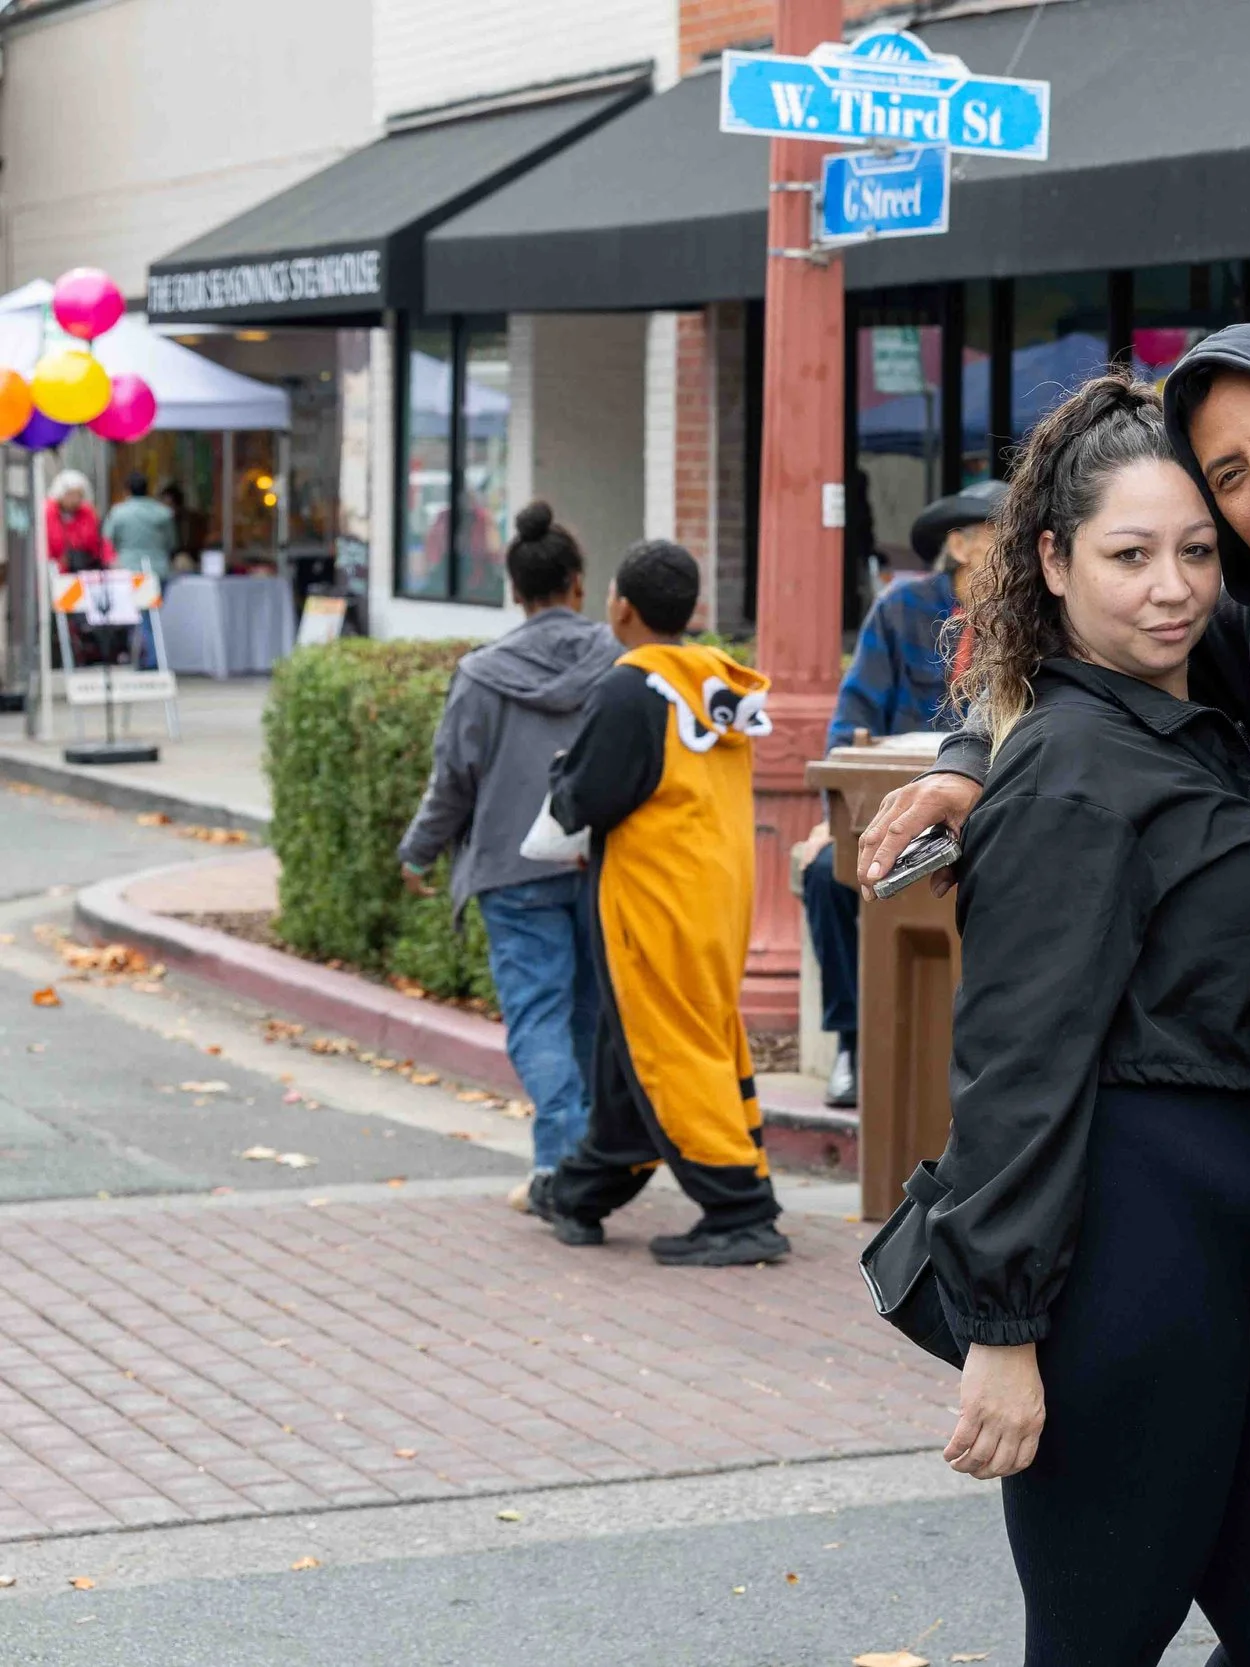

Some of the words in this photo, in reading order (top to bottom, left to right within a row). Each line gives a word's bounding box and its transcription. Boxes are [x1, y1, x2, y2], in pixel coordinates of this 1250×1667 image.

[769, 80, 820, 129] W.
[832, 89, 950, 140] Third
[962, 99, 1005, 146] St
[860, 176, 923, 220] Street
